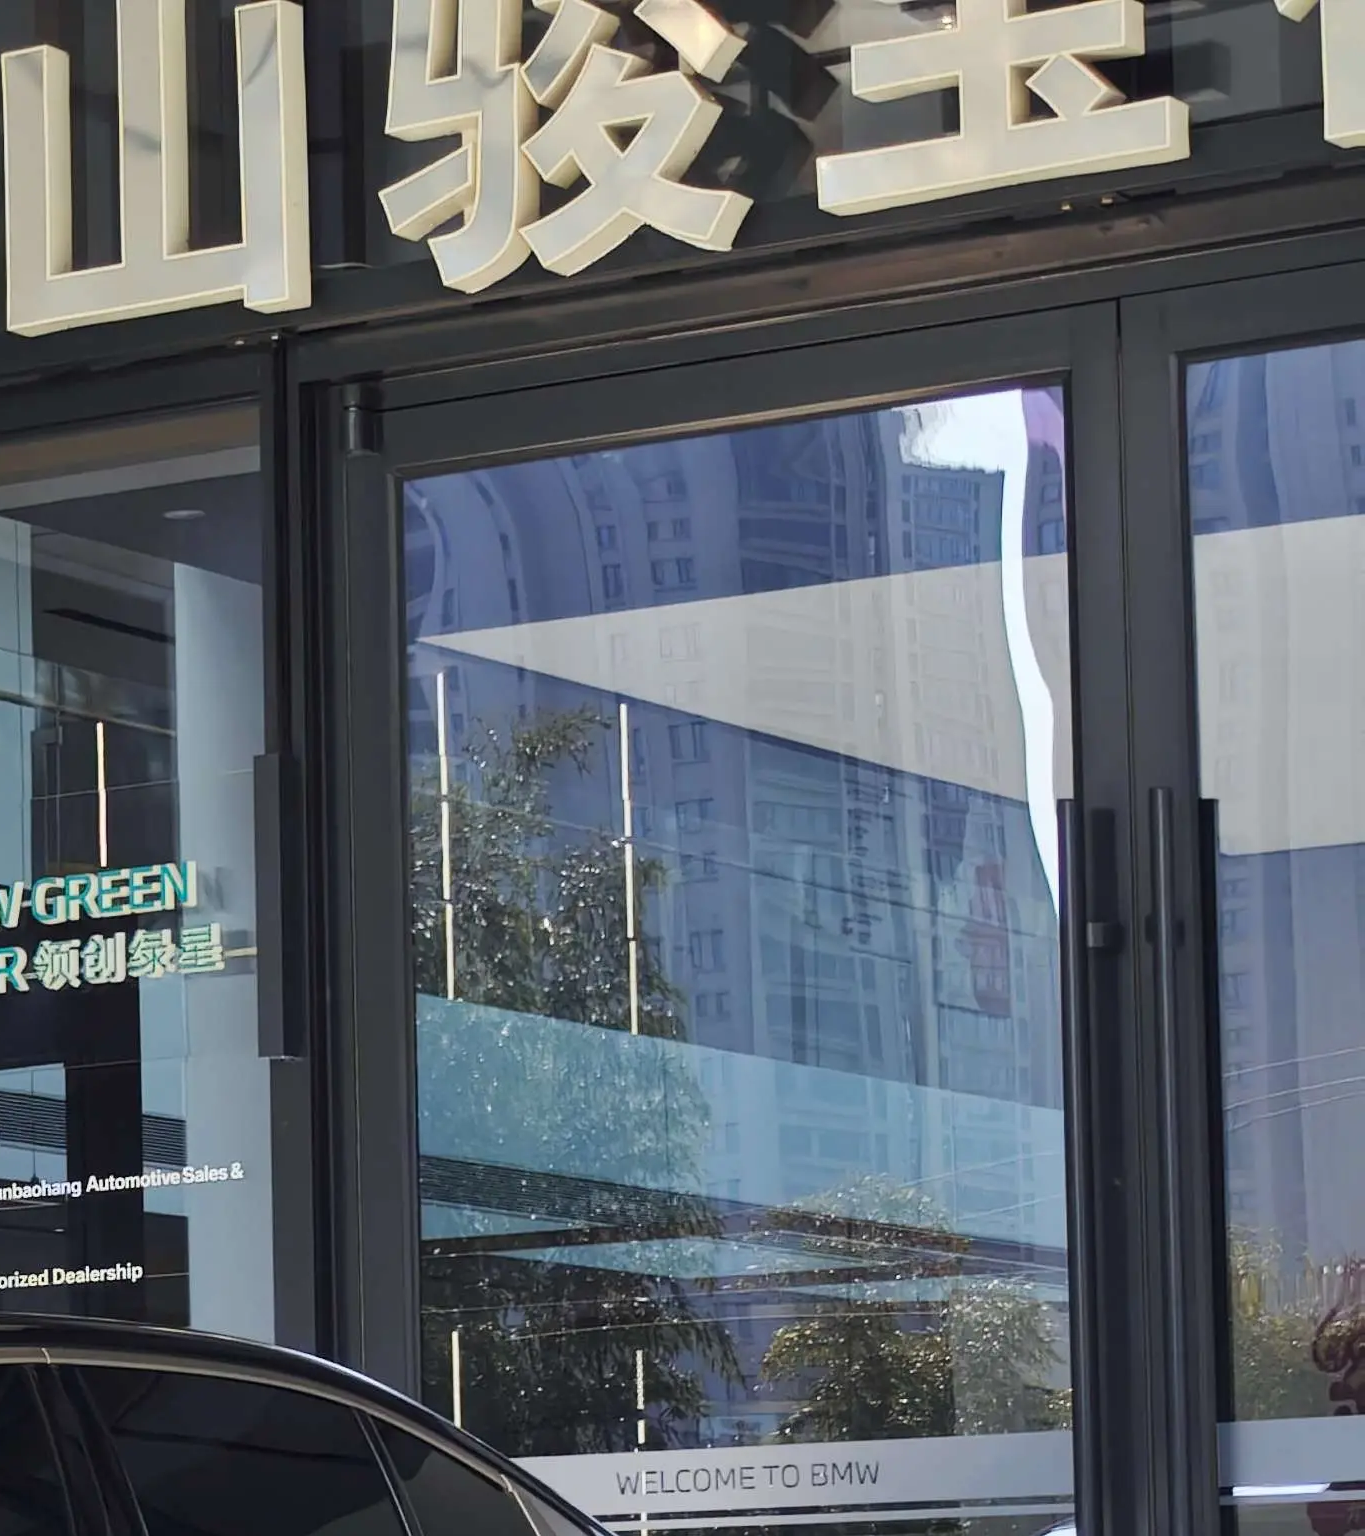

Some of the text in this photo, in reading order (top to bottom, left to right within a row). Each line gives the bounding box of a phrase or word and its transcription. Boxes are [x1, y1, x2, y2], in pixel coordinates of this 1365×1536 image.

[31, 860, 198, 925] GREEN
[86, 1168, 180, 1193] Automotive
[182, 1164, 228, 1184] Sales
[230, 1162, 245, 1180] &
[51, 1262, 144, 1285] Dealership
[615, 1460, 880, 1497] WELCOME TO BMW
